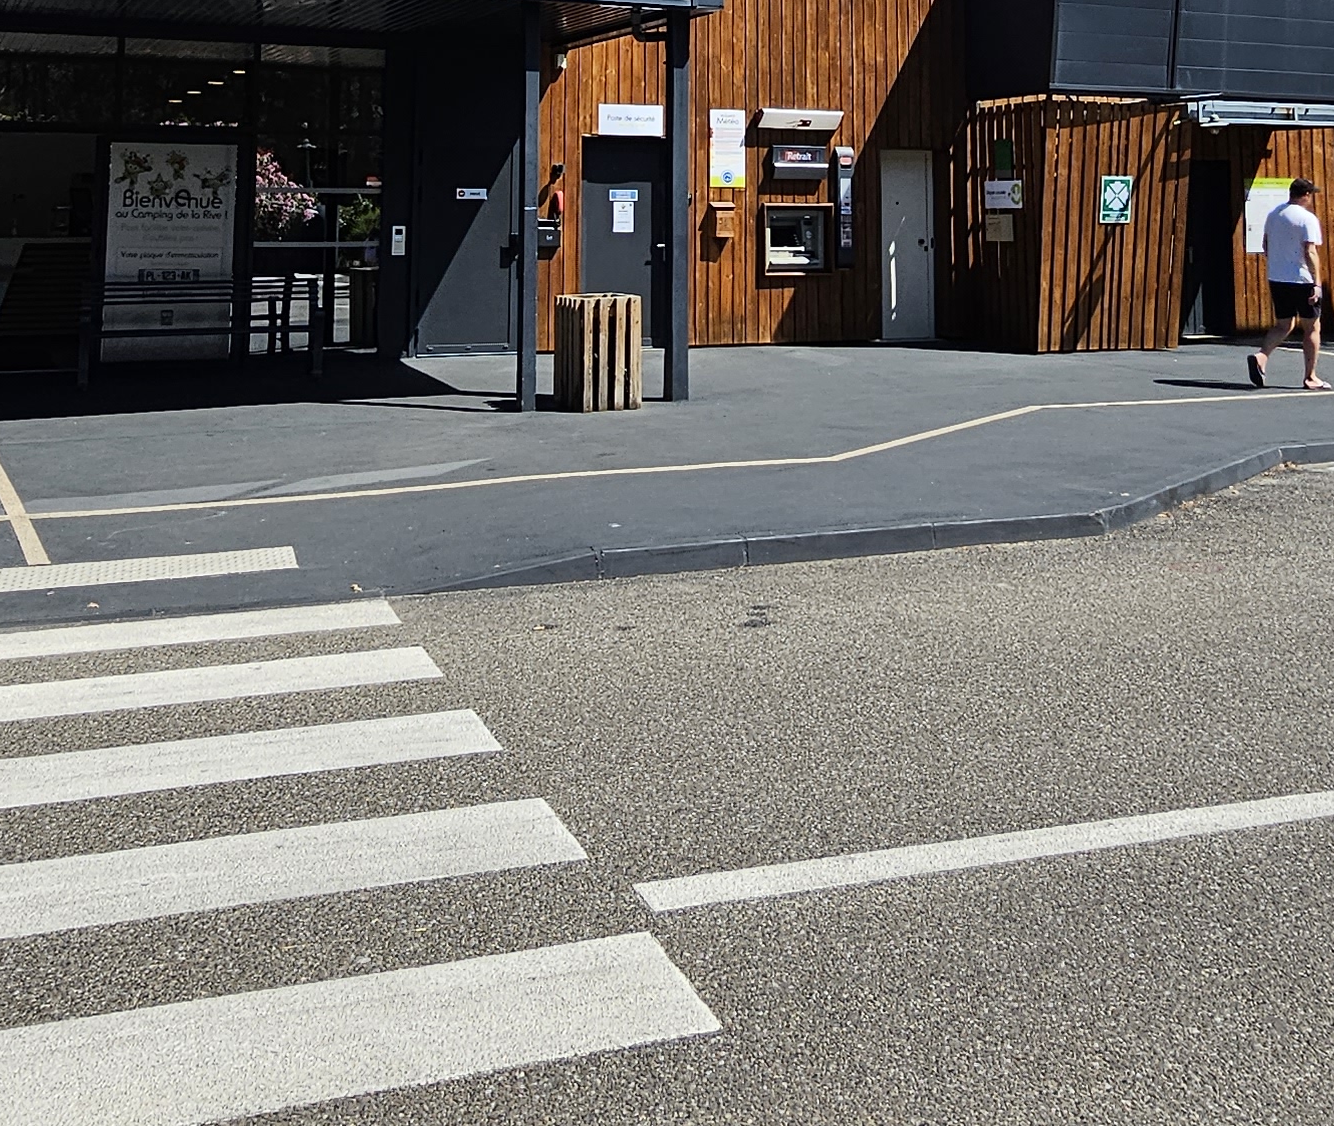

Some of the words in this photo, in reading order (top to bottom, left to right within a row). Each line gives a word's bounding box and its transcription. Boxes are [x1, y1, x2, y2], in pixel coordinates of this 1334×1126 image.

[607, 114, 623, 122] Poste
[624, 114, 633, 122] de
[786, 151, 812, 161] Retrait
[115, 210, 129, 219] au
[131, 208, 173, 222] Camping
[176, 209, 190, 219] de
[191, 209, 201, 219] la
[203, 209, 222, 220] Rive
